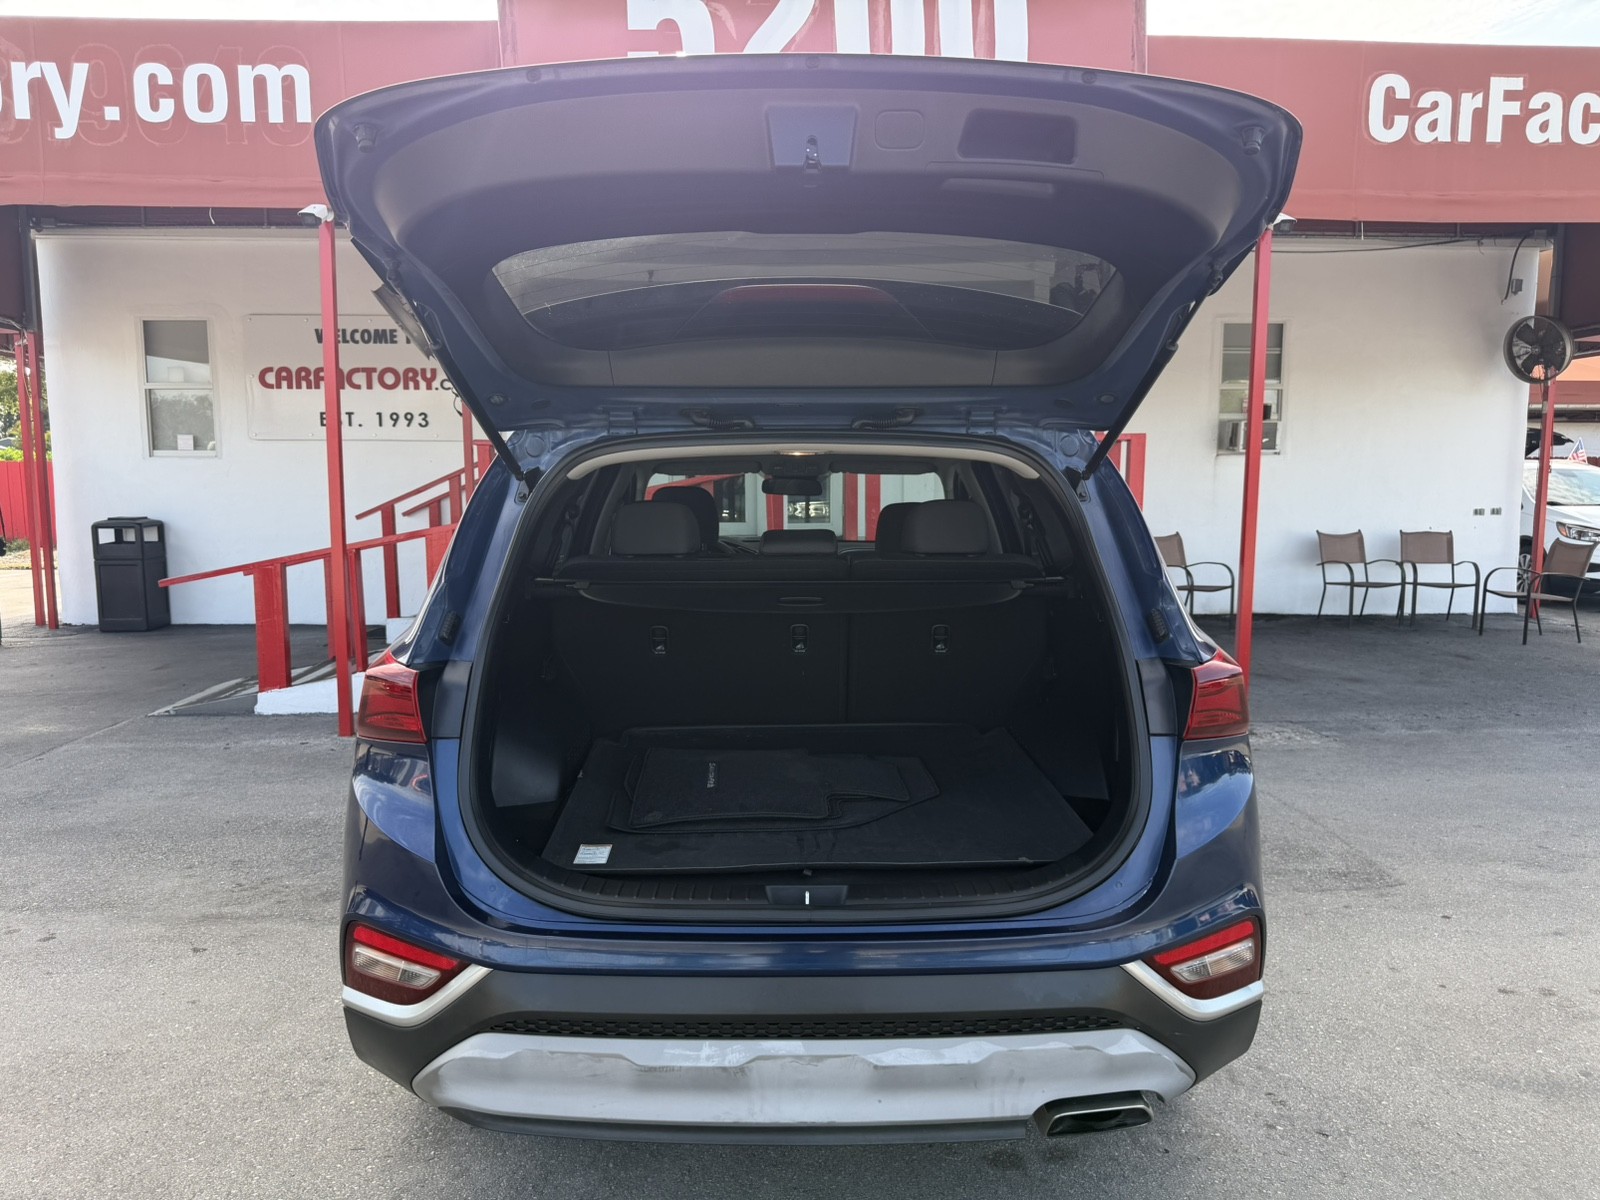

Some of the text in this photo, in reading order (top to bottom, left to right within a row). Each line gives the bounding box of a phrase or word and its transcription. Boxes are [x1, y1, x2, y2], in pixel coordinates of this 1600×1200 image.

[0, 61, 312, 139] ry.com
[1368, 73, 1600, 145] CarFac
[319, 411, 429, 428] ET. 1993
